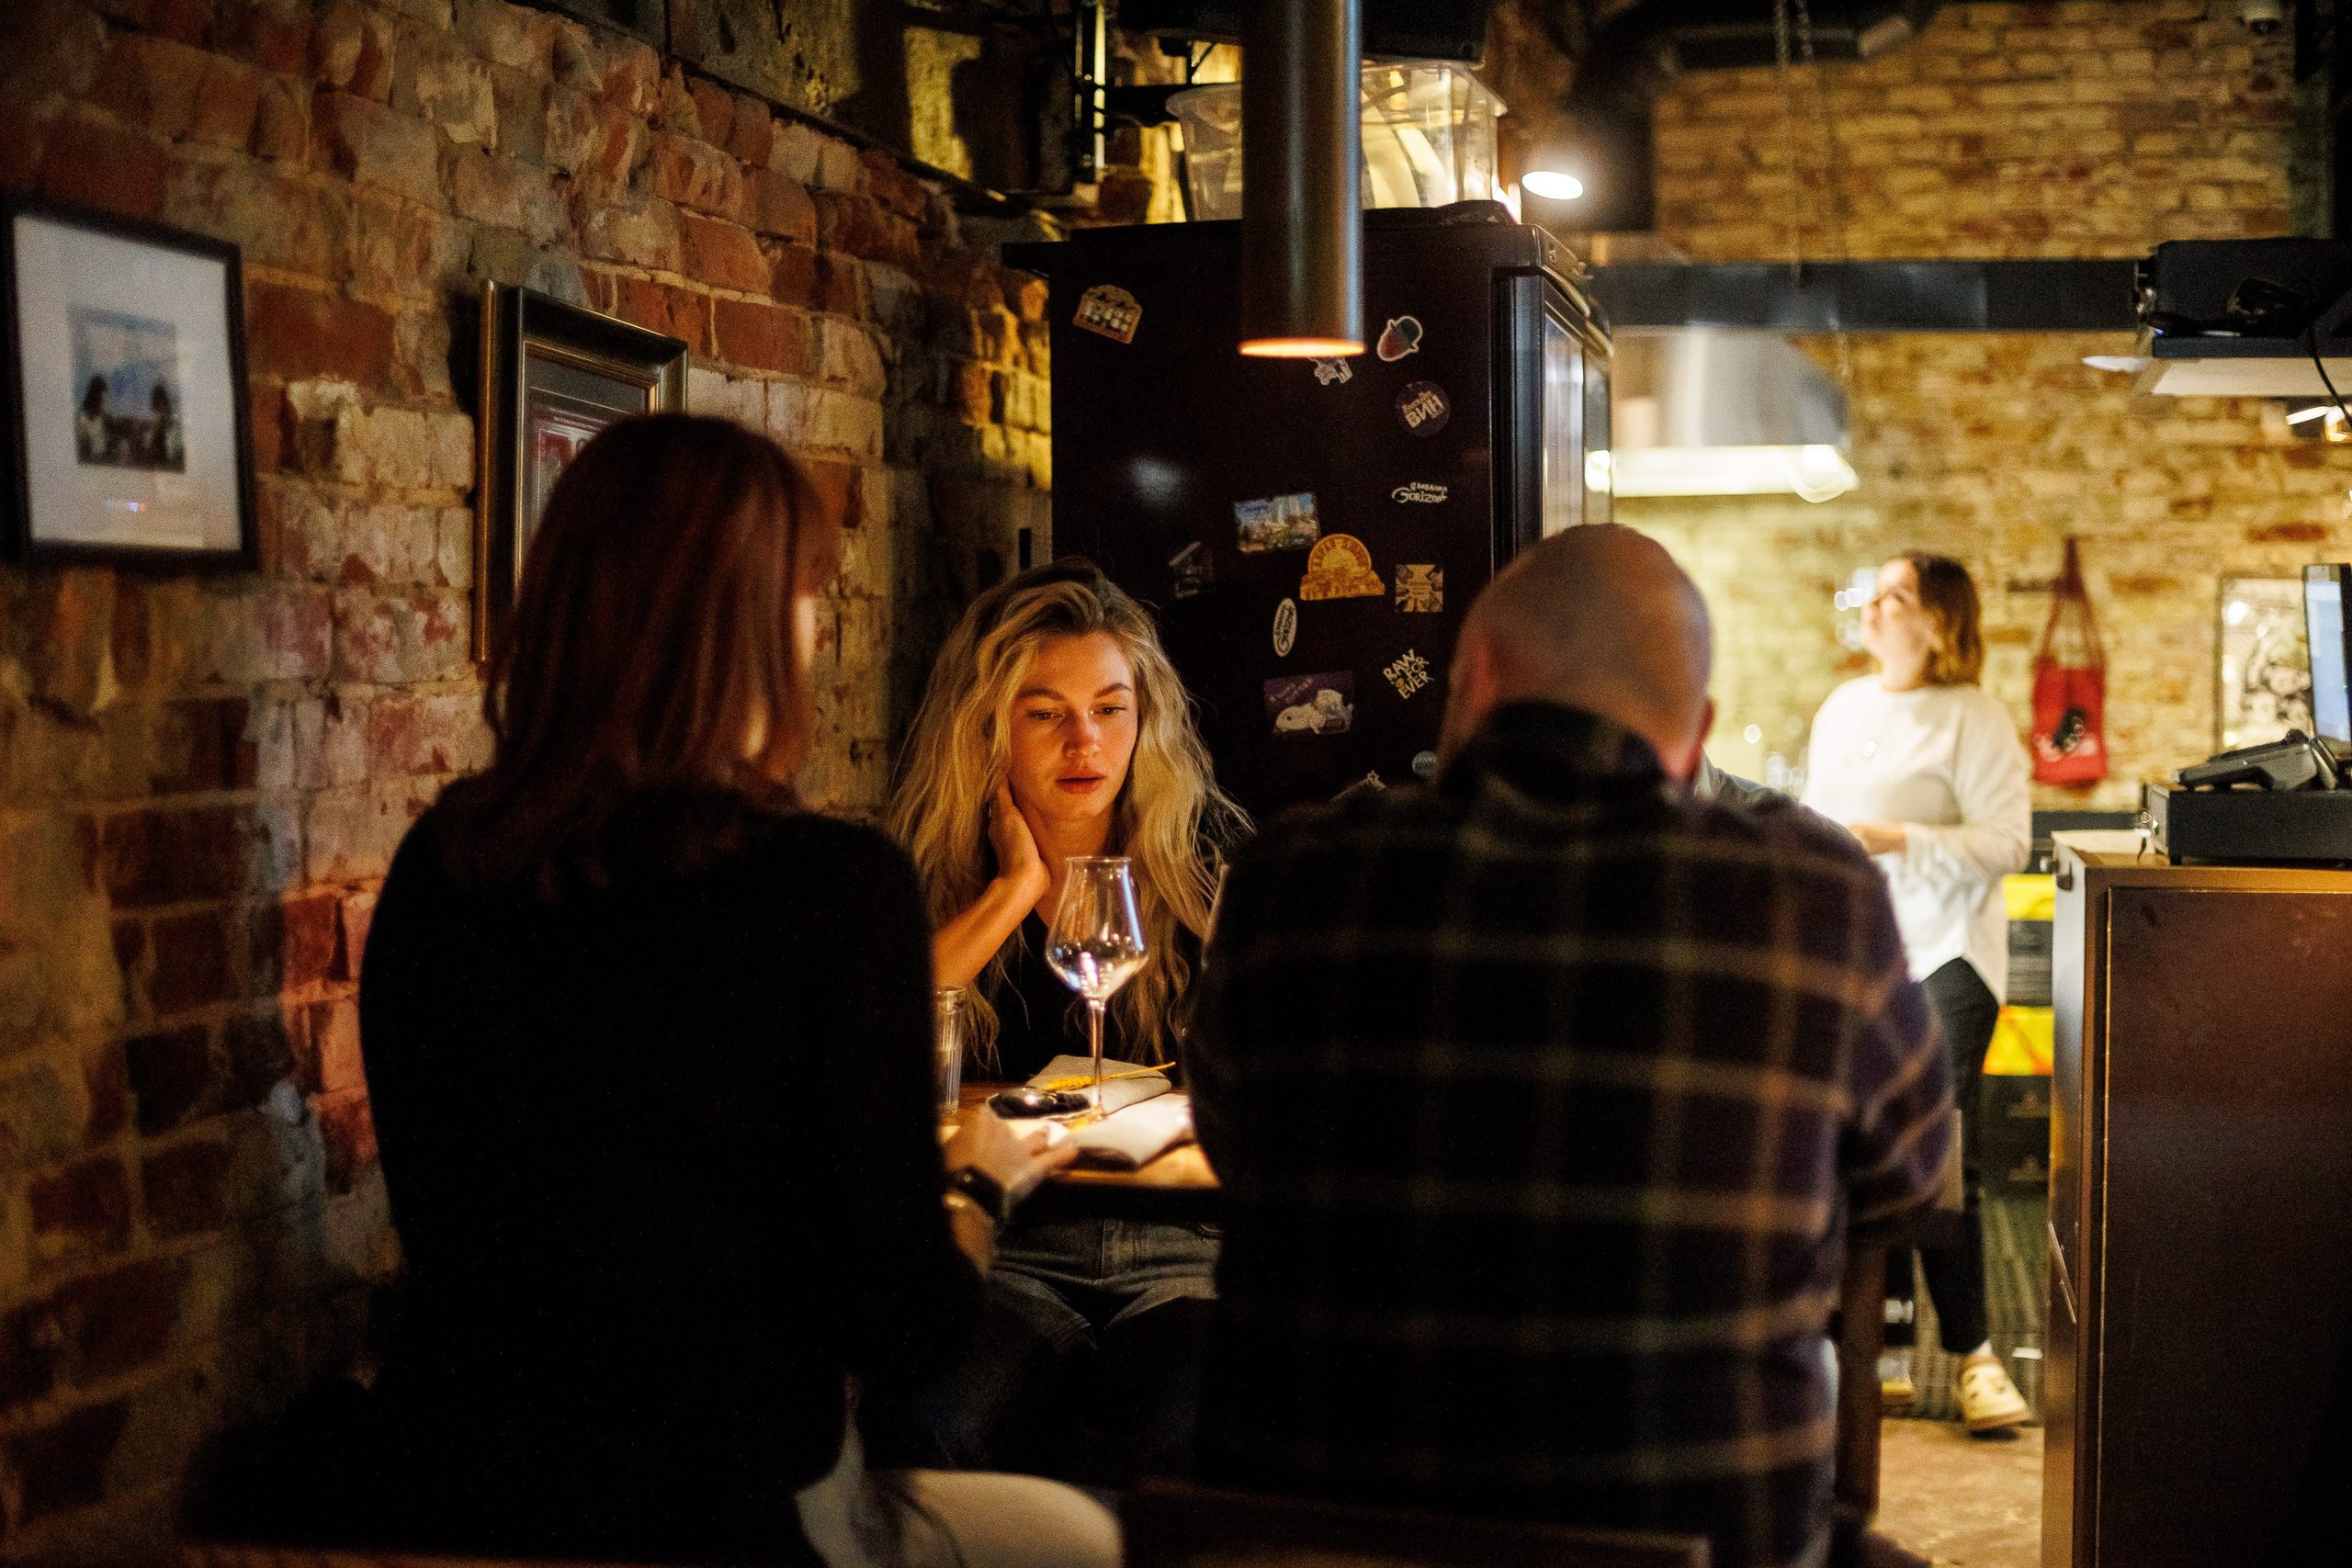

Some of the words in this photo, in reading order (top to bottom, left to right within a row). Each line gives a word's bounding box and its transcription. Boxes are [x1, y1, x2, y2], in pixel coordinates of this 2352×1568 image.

[1383, 649, 1416, 685] RAW
[1405, 656, 1430, 681] FOR
[1397, 671, 1433, 699] EVER
